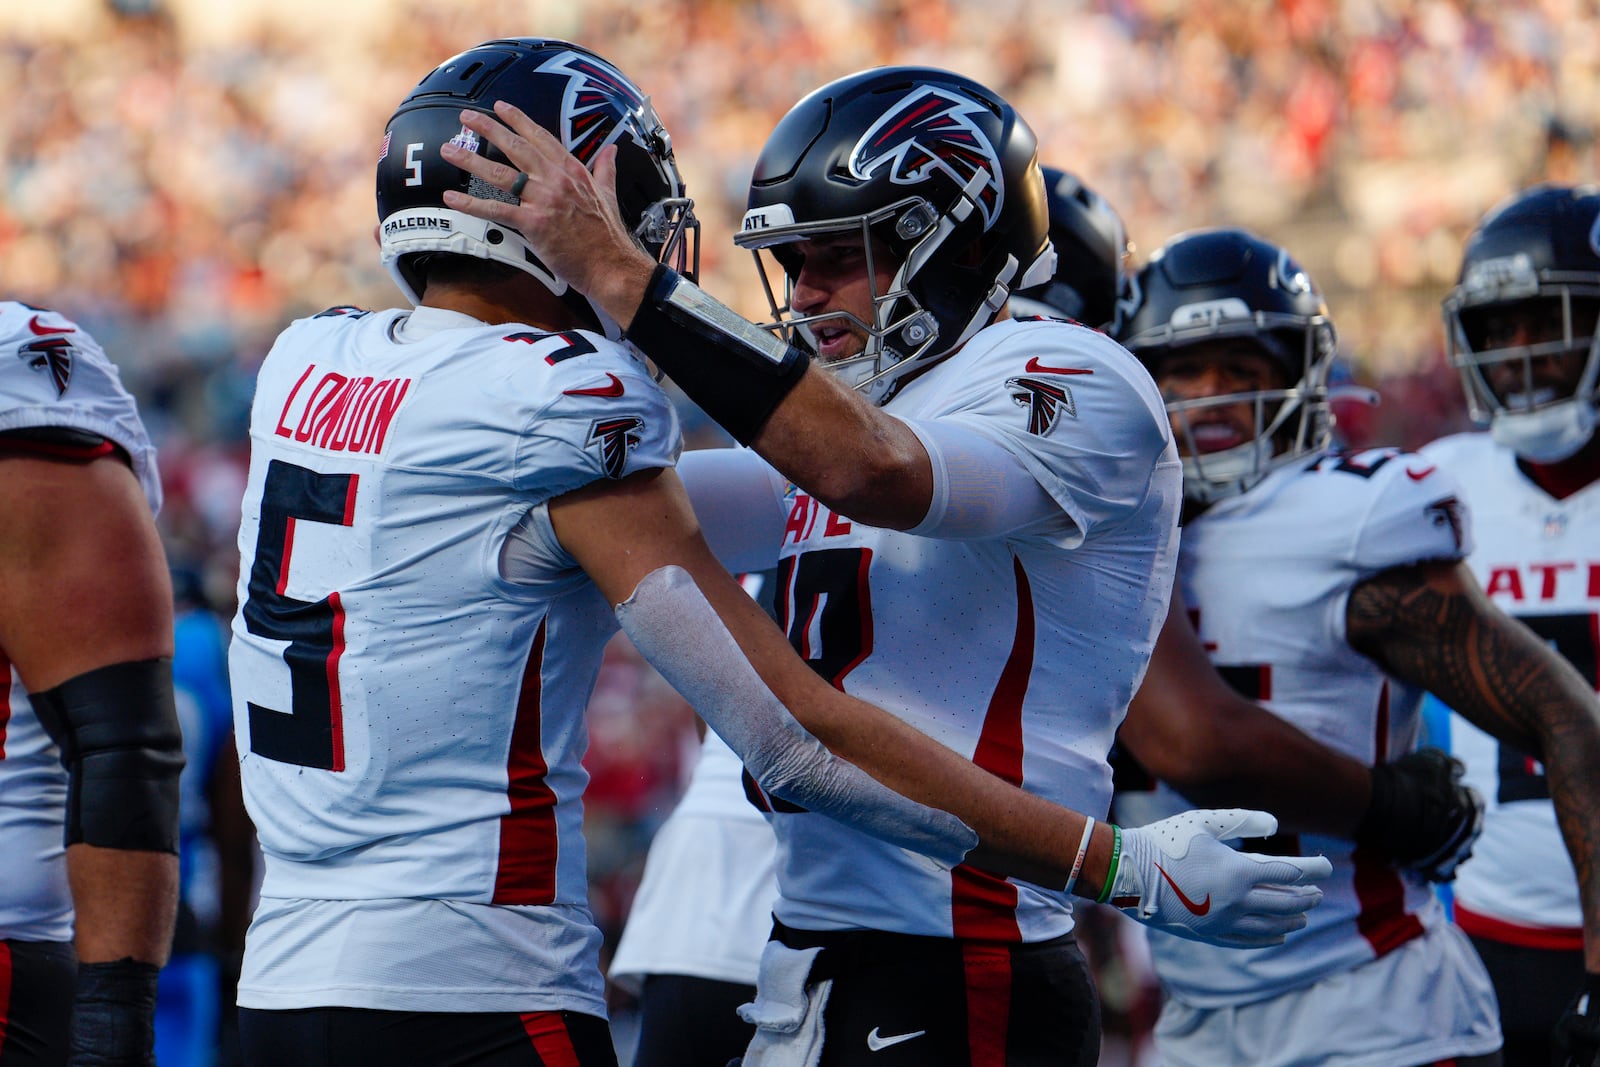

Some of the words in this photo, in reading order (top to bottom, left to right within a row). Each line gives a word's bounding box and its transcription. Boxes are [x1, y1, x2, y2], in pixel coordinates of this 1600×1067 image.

[404, 143, 424, 187] 5
[384, 217, 451, 235] FALCONS
[745, 214, 770, 230] ATL
[275, 364, 411, 455] LONDON
[243, 459, 360, 773] 5
